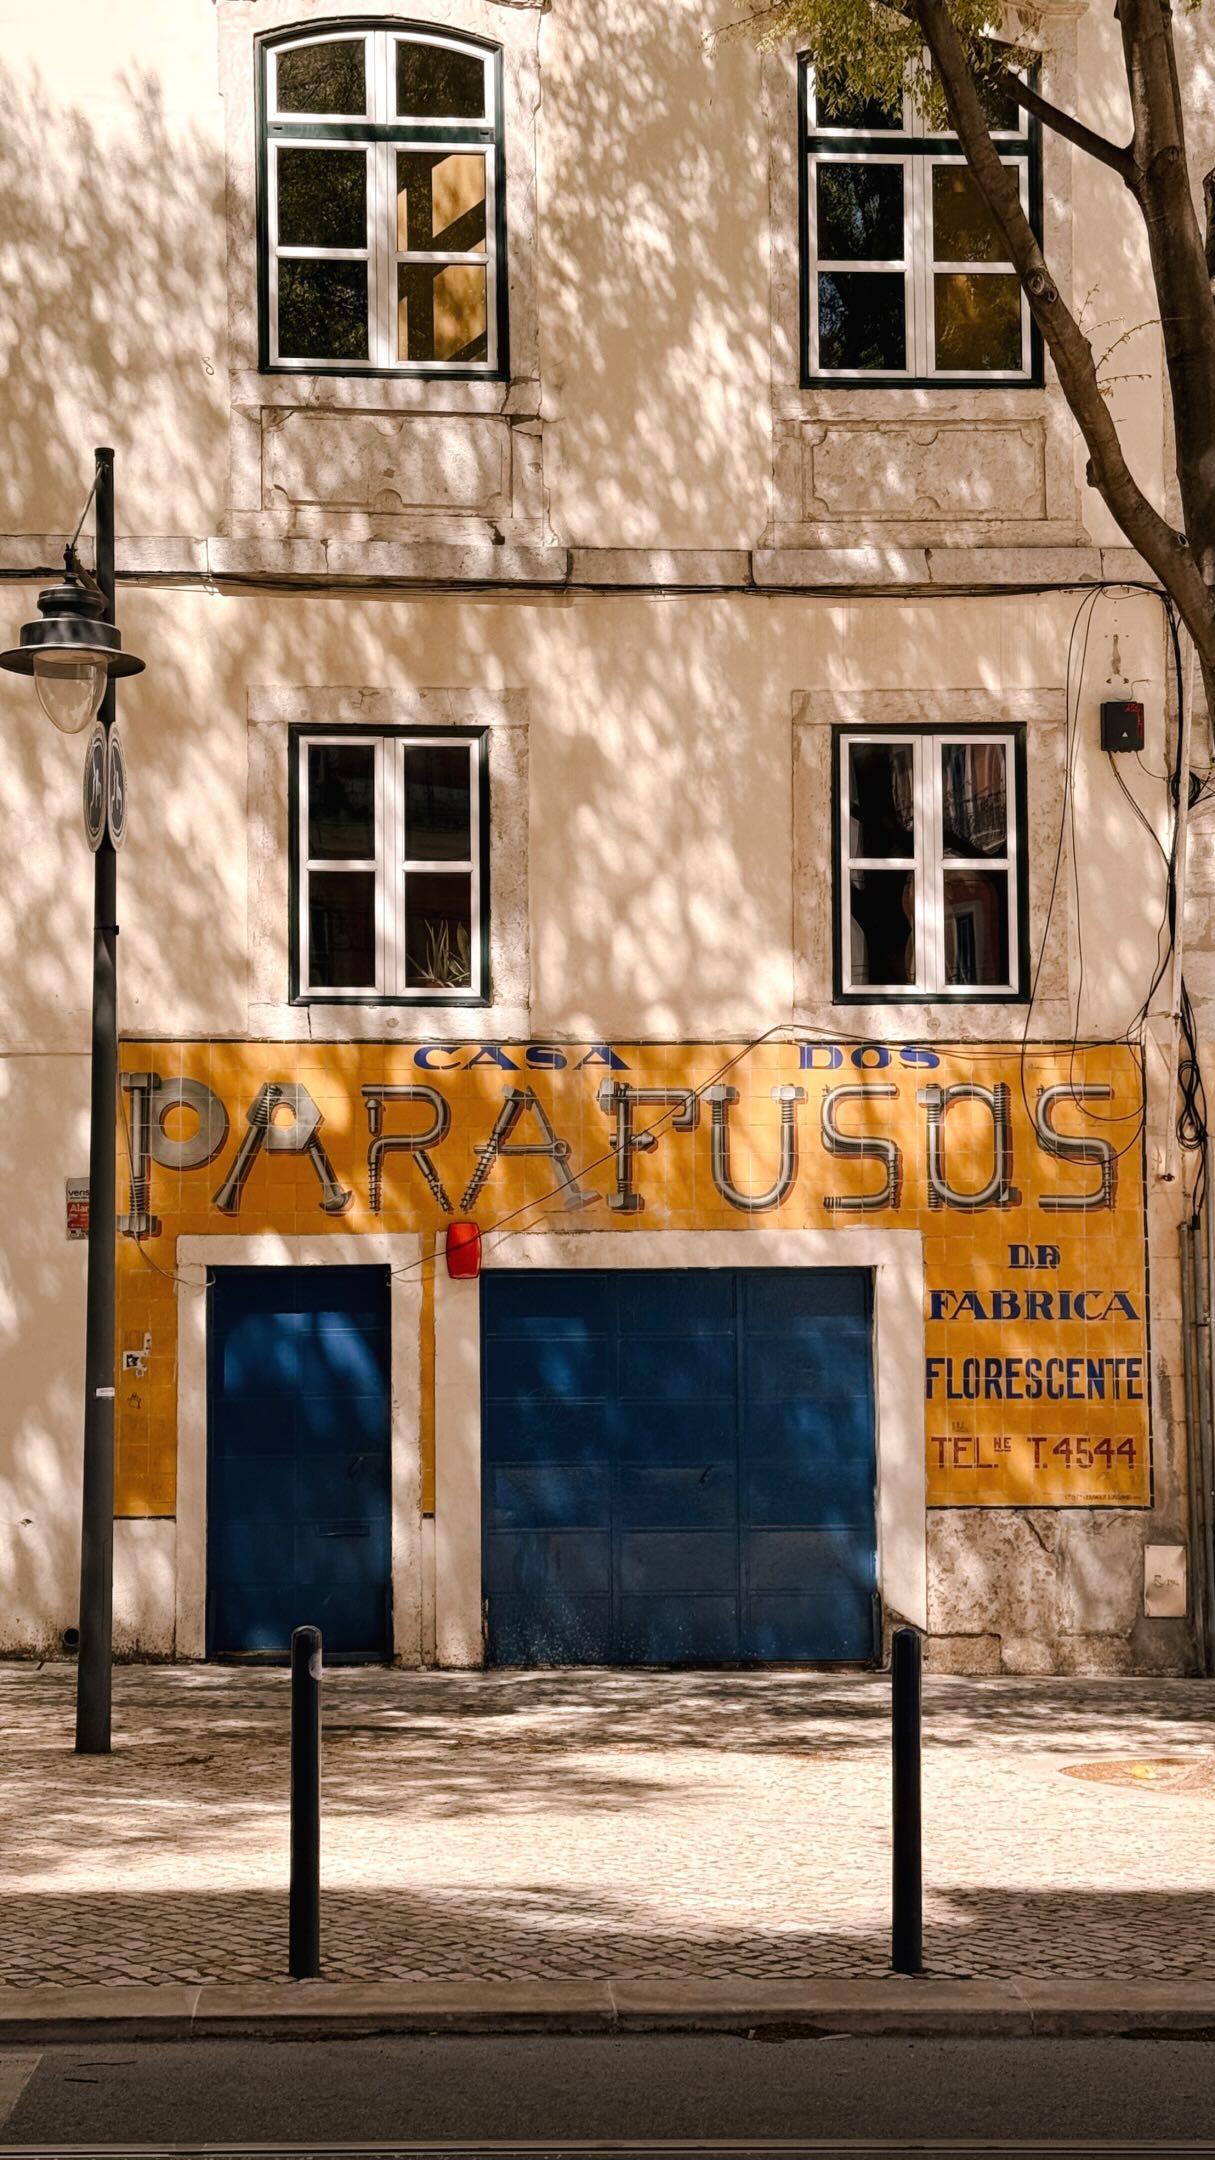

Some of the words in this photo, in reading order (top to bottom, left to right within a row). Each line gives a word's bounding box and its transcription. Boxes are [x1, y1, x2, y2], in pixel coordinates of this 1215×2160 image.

[413, 1046, 632, 1070] CASA
[799, 1046, 940, 1069] DOS
[117, 1071, 1116, 1238] PARAFUSOS
[928, 1290, 1140, 1320] FABRICA
[926, 1358, 1143, 1399] FLORESCENTE
